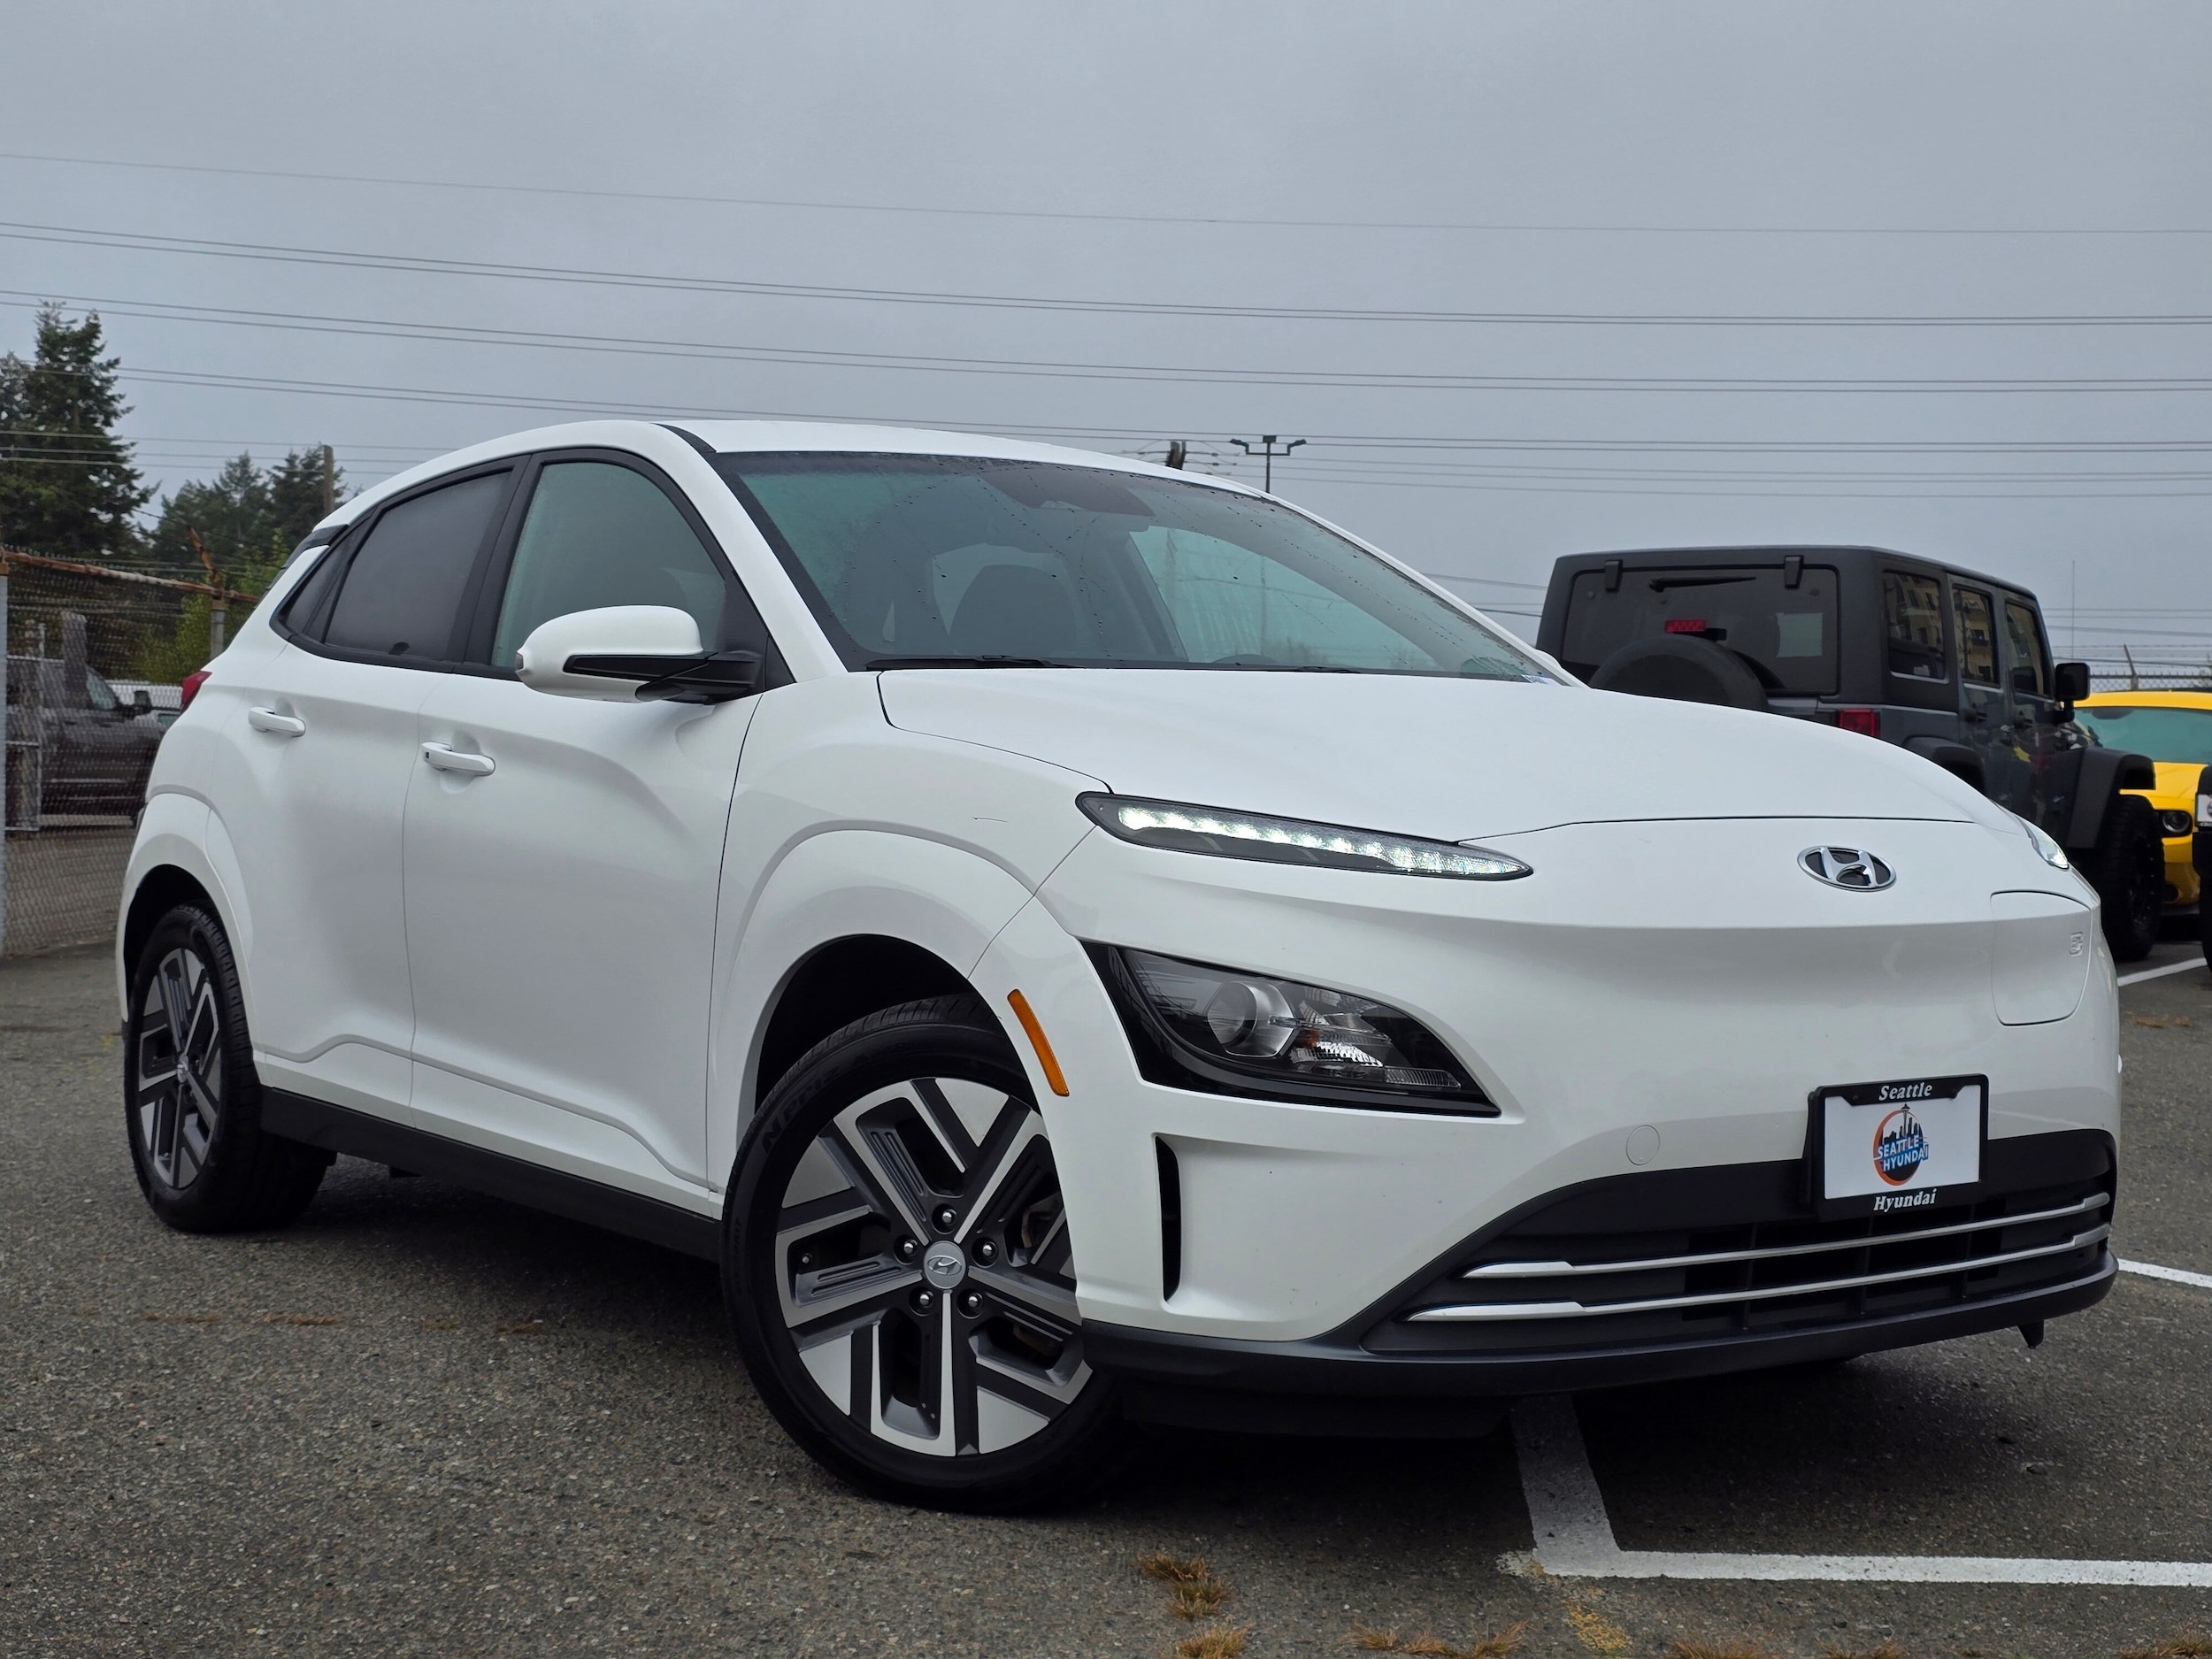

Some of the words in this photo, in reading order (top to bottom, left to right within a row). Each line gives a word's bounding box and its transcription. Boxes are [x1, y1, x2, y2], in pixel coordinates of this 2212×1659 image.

[1878, 1081, 1933, 1102] Seattle
[1878, 1134, 1920, 1159] SEATTLE
[1883, 1145, 1929, 1171] HYUNDAI
[1873, 1187, 1938, 1213] Hyundai
